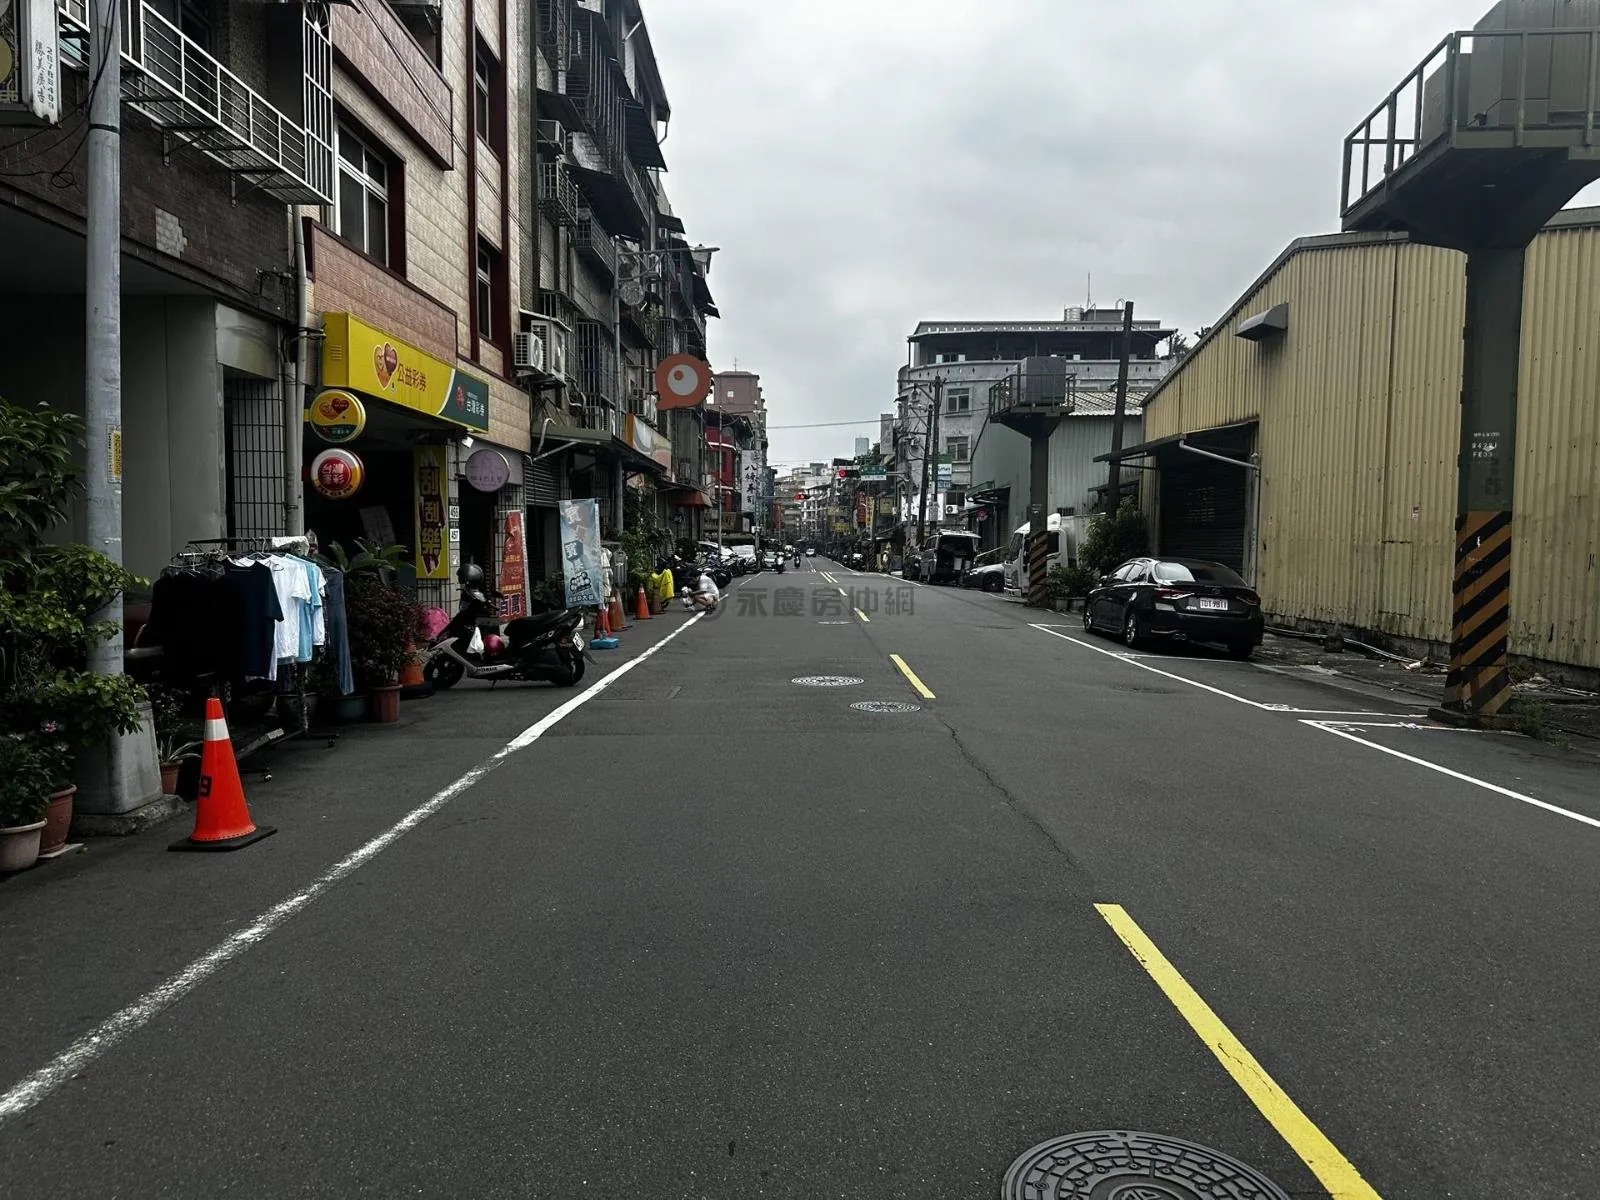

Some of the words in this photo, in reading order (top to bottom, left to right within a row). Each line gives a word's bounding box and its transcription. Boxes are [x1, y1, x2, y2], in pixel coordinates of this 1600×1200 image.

[397, 363, 427, 392] 公益彩券
[420, 467, 441, 556] 刮刮樂
